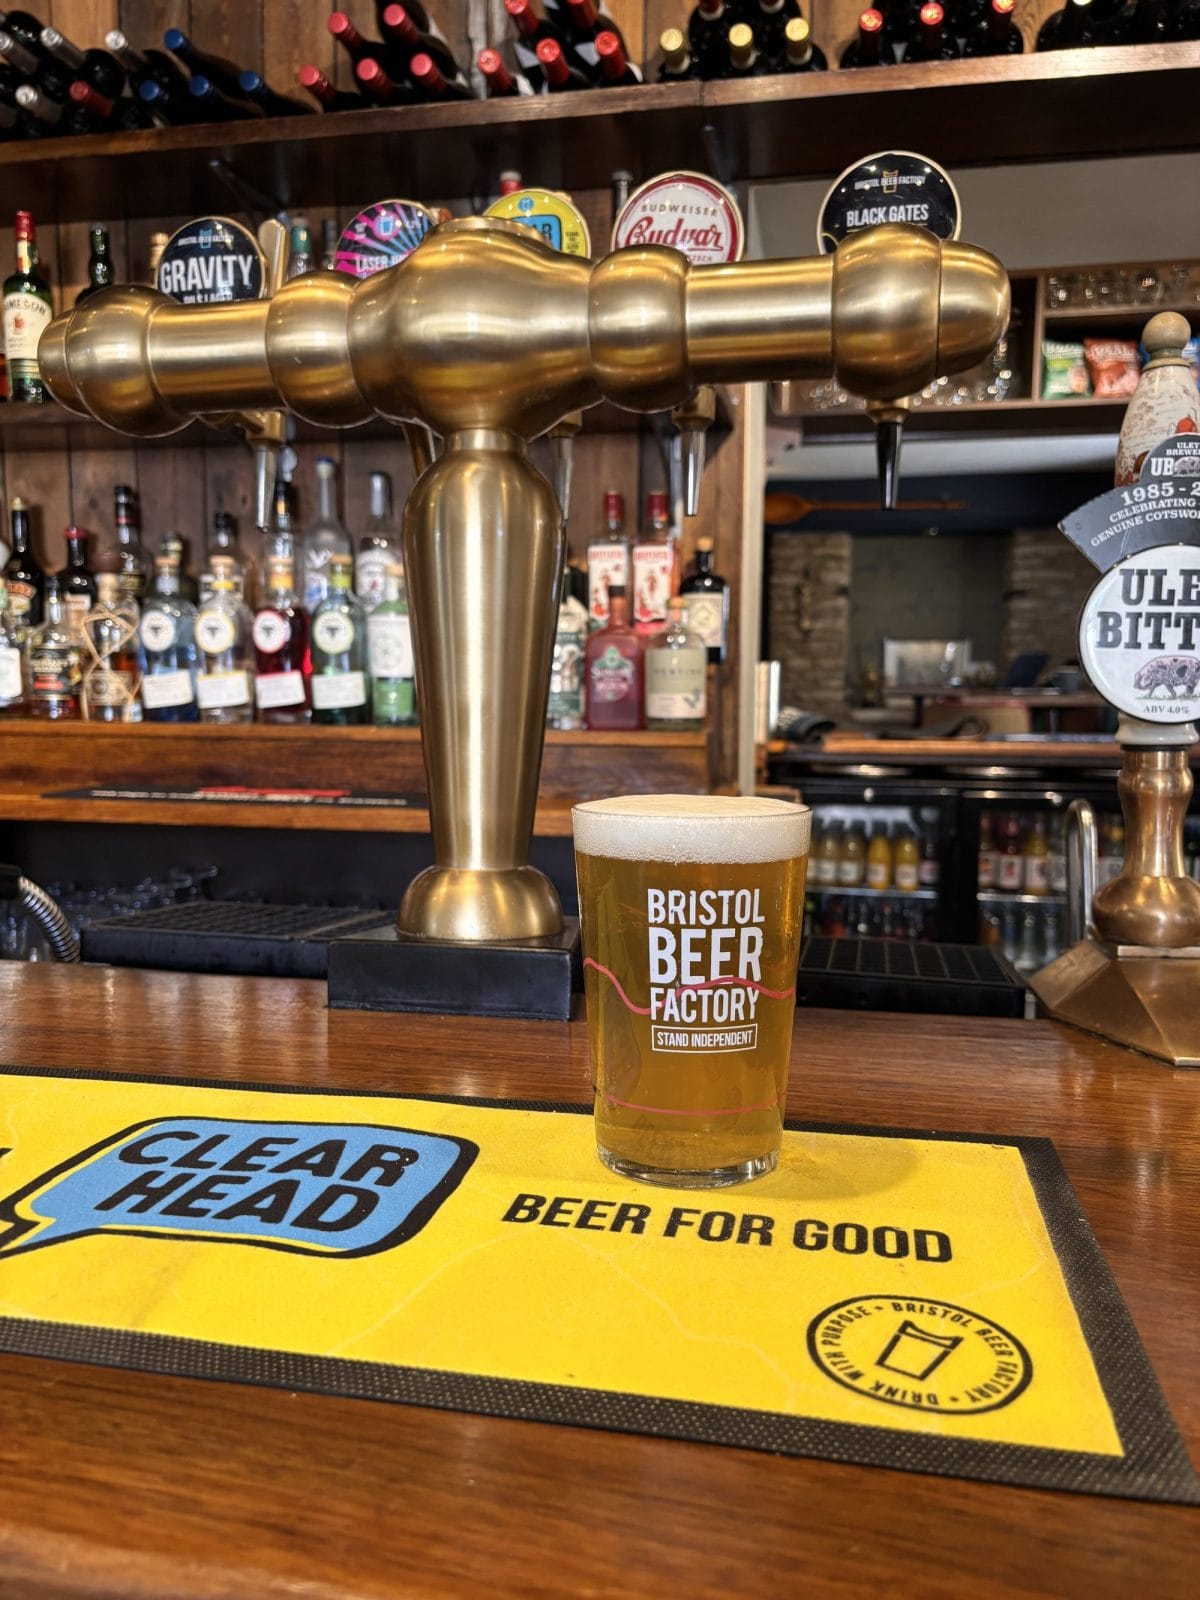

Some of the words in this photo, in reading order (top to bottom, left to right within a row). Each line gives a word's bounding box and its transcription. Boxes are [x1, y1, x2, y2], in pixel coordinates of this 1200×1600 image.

[641, 204, 718, 216] BUDWEISER
[846, 207, 887, 227] BLACK
[889, 203, 929, 221] GATES
[625, 216, 723, 251] Budvar
[161, 255, 253, 294] GRAVITY
[1109, 498, 1196, 523] CELEBRATING
[1121, 481, 1174, 507] 1985
[1090, 515, 1143, 547] GENUINE
[1119, 568, 1200, 606] ULE
[1095, 611, 1200, 650] BITT
[1143, 704, 1166, 714] ABV
[647, 888, 766, 926] BRISTOL
[648, 926, 764, 985] BEER
[650, 986, 760, 1023] FACTORY
[657, 1031, 689, 1048] STAND
[691, 1030, 754, 1048] INDEPENDENT
[118, 1131, 419, 1187] CLEAR
[94, 1170, 380, 1232] HEAD
[501, 1193, 651, 1235] BEER
[662, 1206, 773, 1247] FOR
[792, 1218, 954, 1263] GOOD
[820, 1305, 872, 1347] PURPOSE
[890, 1301, 974, 1328] BRISTOL
[975, 1327, 1014, 1358] BEER
[824, 1351, 865, 1382] WITH
[963, 1359, 1019, 1403] FACTORY
[868, 1379, 940, 1406] DRINK
